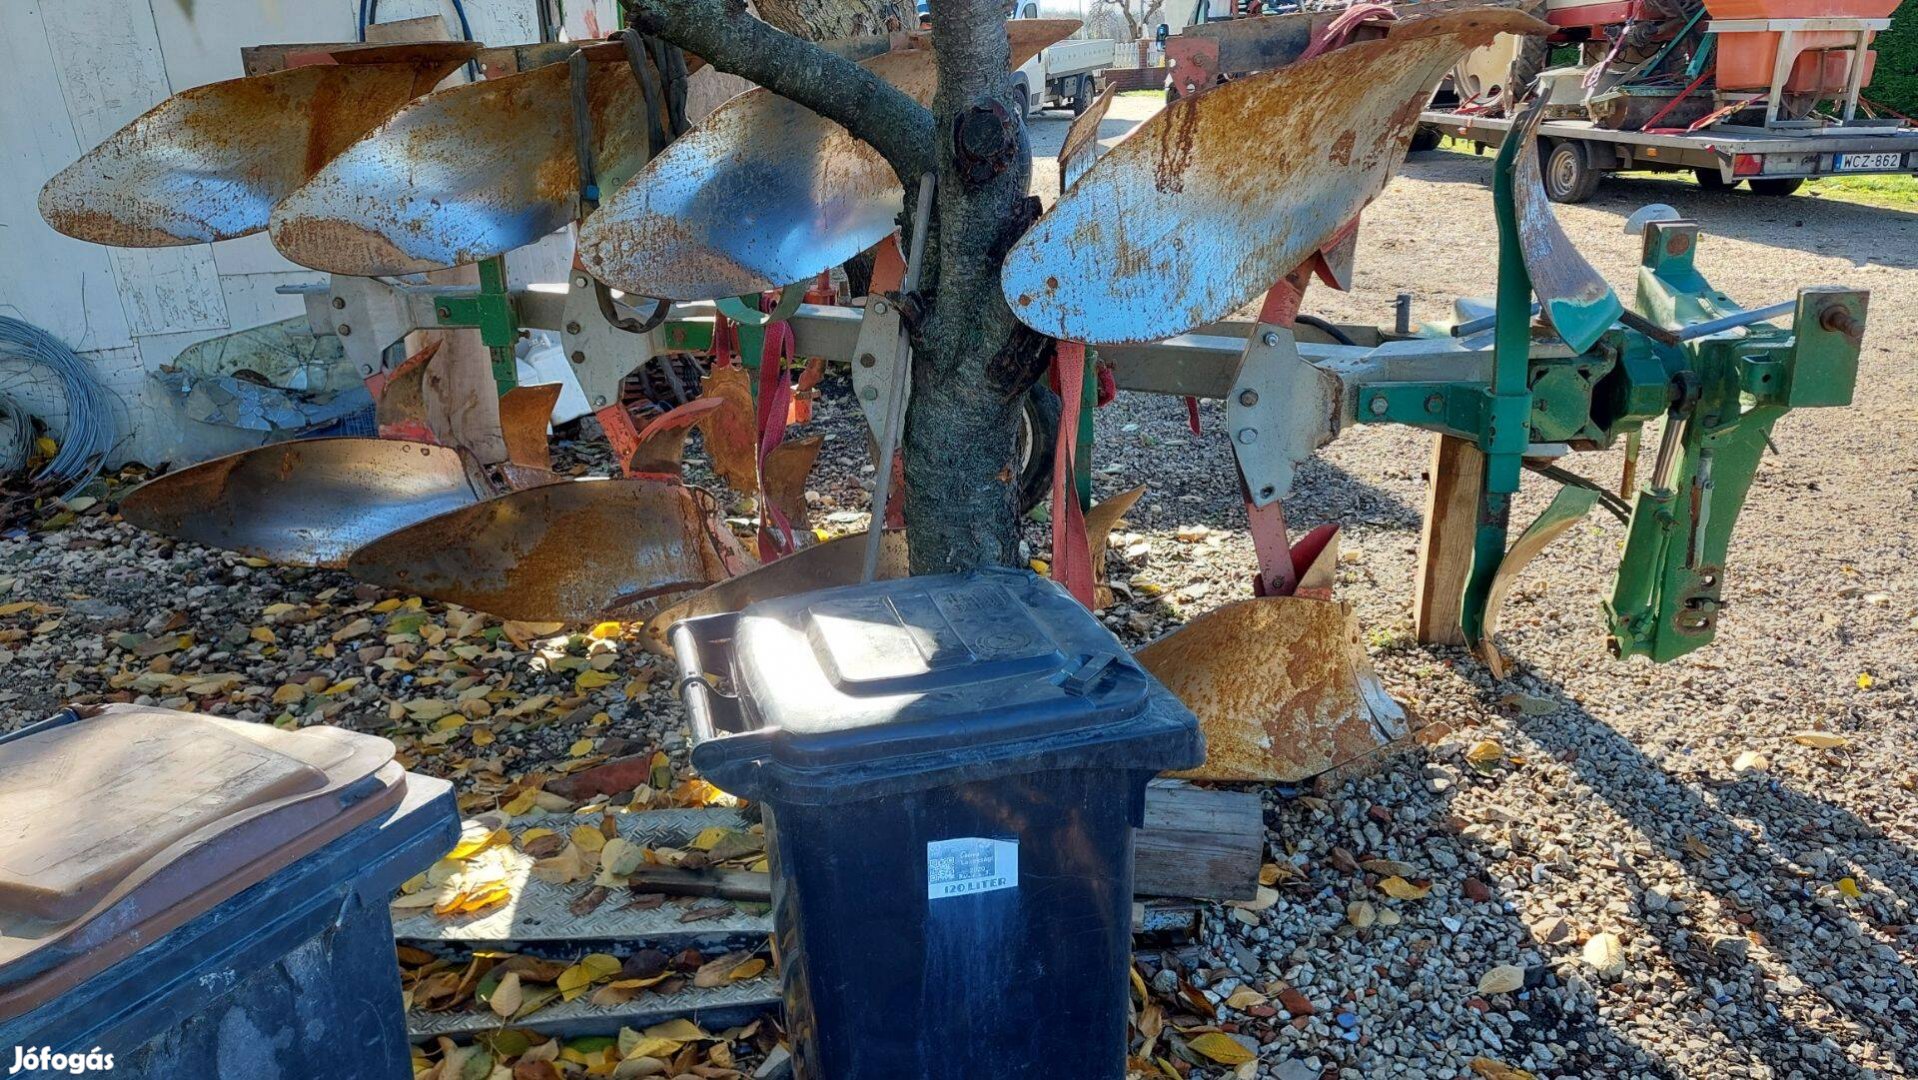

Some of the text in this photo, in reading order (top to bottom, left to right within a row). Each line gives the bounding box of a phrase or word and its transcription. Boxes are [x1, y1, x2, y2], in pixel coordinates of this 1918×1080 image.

[1844, 154, 1898, 168] WCZ-862
[944, 877, 1007, 894] 120 LITER
